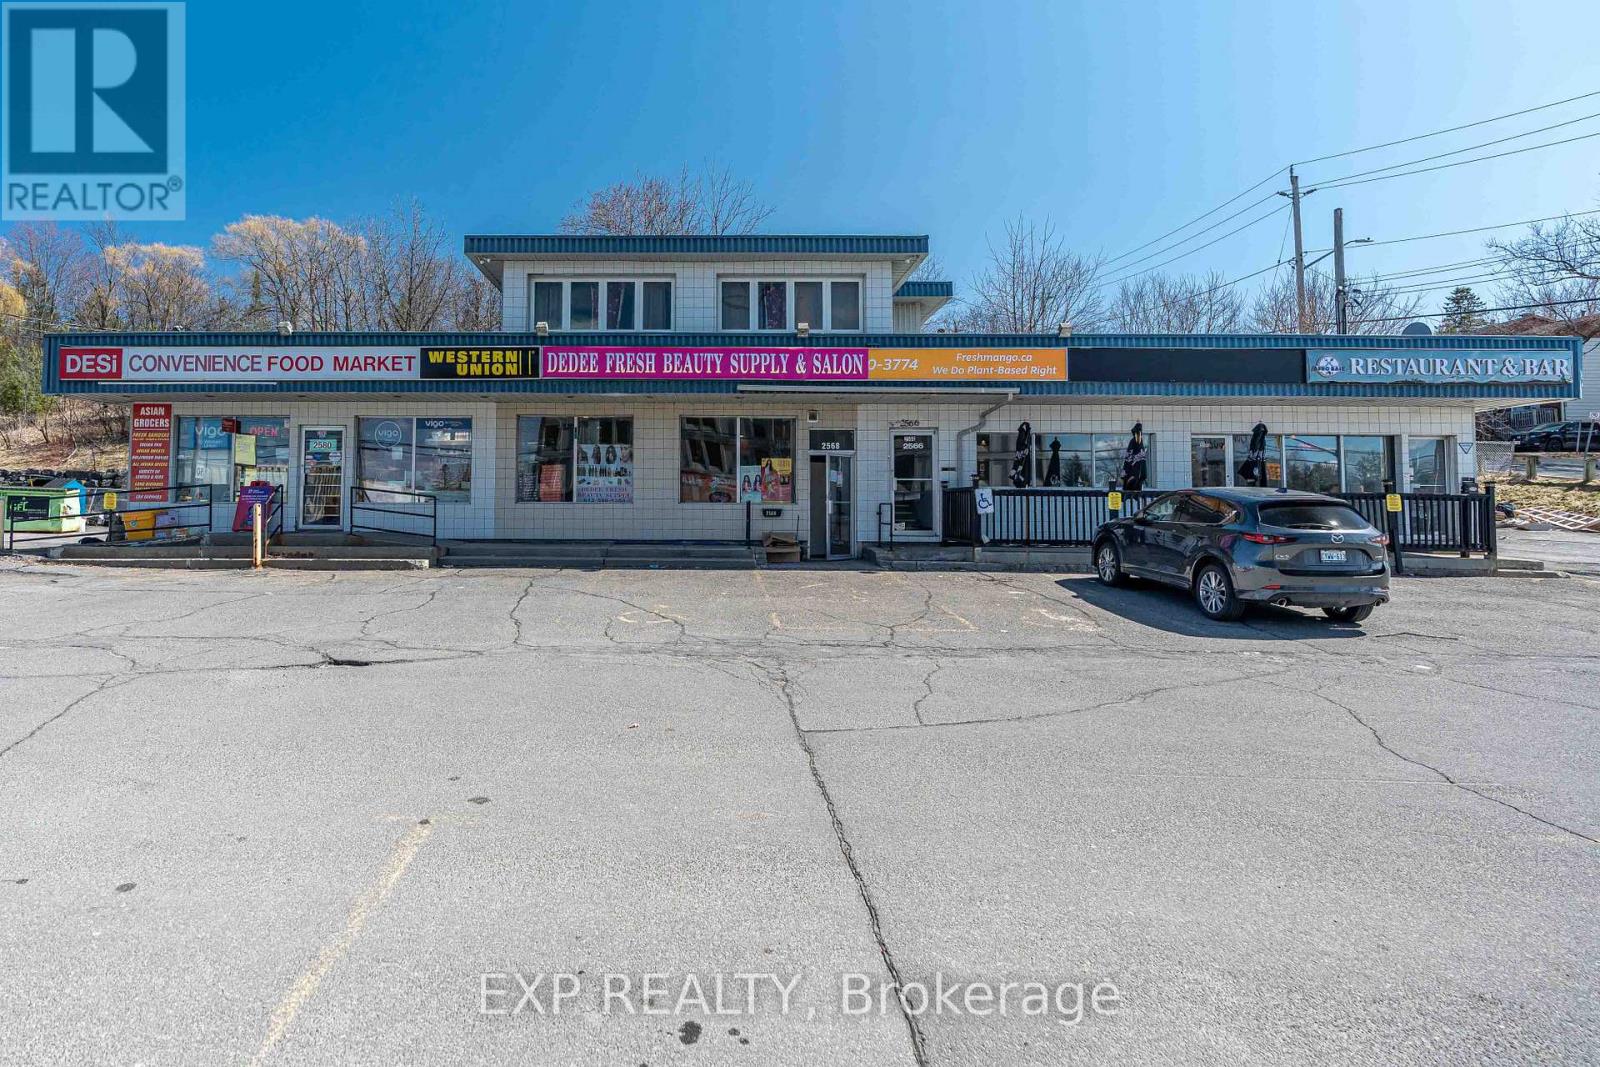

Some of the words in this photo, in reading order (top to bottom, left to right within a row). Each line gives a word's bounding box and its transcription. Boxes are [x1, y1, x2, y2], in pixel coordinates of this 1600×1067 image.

[429, 350, 518, 363] WESTERN
[956, 352, 1033, 364] Freshmango.ca
[128, 354, 262, 373] CONVENIENCE
[267, 355, 324, 373] FOOD
[333, 355, 417, 373] MARKET
[547, 352, 599, 374] DEDEE
[605, 352, 656, 374] FRESH
[663, 352, 724, 374] BEAUTY
[730, 352, 790, 375] SUPPLY
[796, 353, 807, 375] &
[812, 353, 864, 375] SALON
[1350, 357, 1498, 376] RESTAURANT
[1500, 356, 1520, 377] &
[1522, 357, 1570, 377] BAR
[456, 363, 518, 376] UNION
[932, 366, 948, 375] We
[951, 366, 965, 375] Do
[967, 366, 1029, 375] Plant-Based
[1030, 366, 1057, 377] Right
[140, 406, 165, 416] ASIAN
[133, 418, 170, 428] GROCERS
[425, 420, 445, 428] vigo
[249, 426, 278, 437] OPEN
[378, 429, 399, 438] vigo
[821, 442, 840, 450] 2568
[902, 442, 924, 450] 2566
